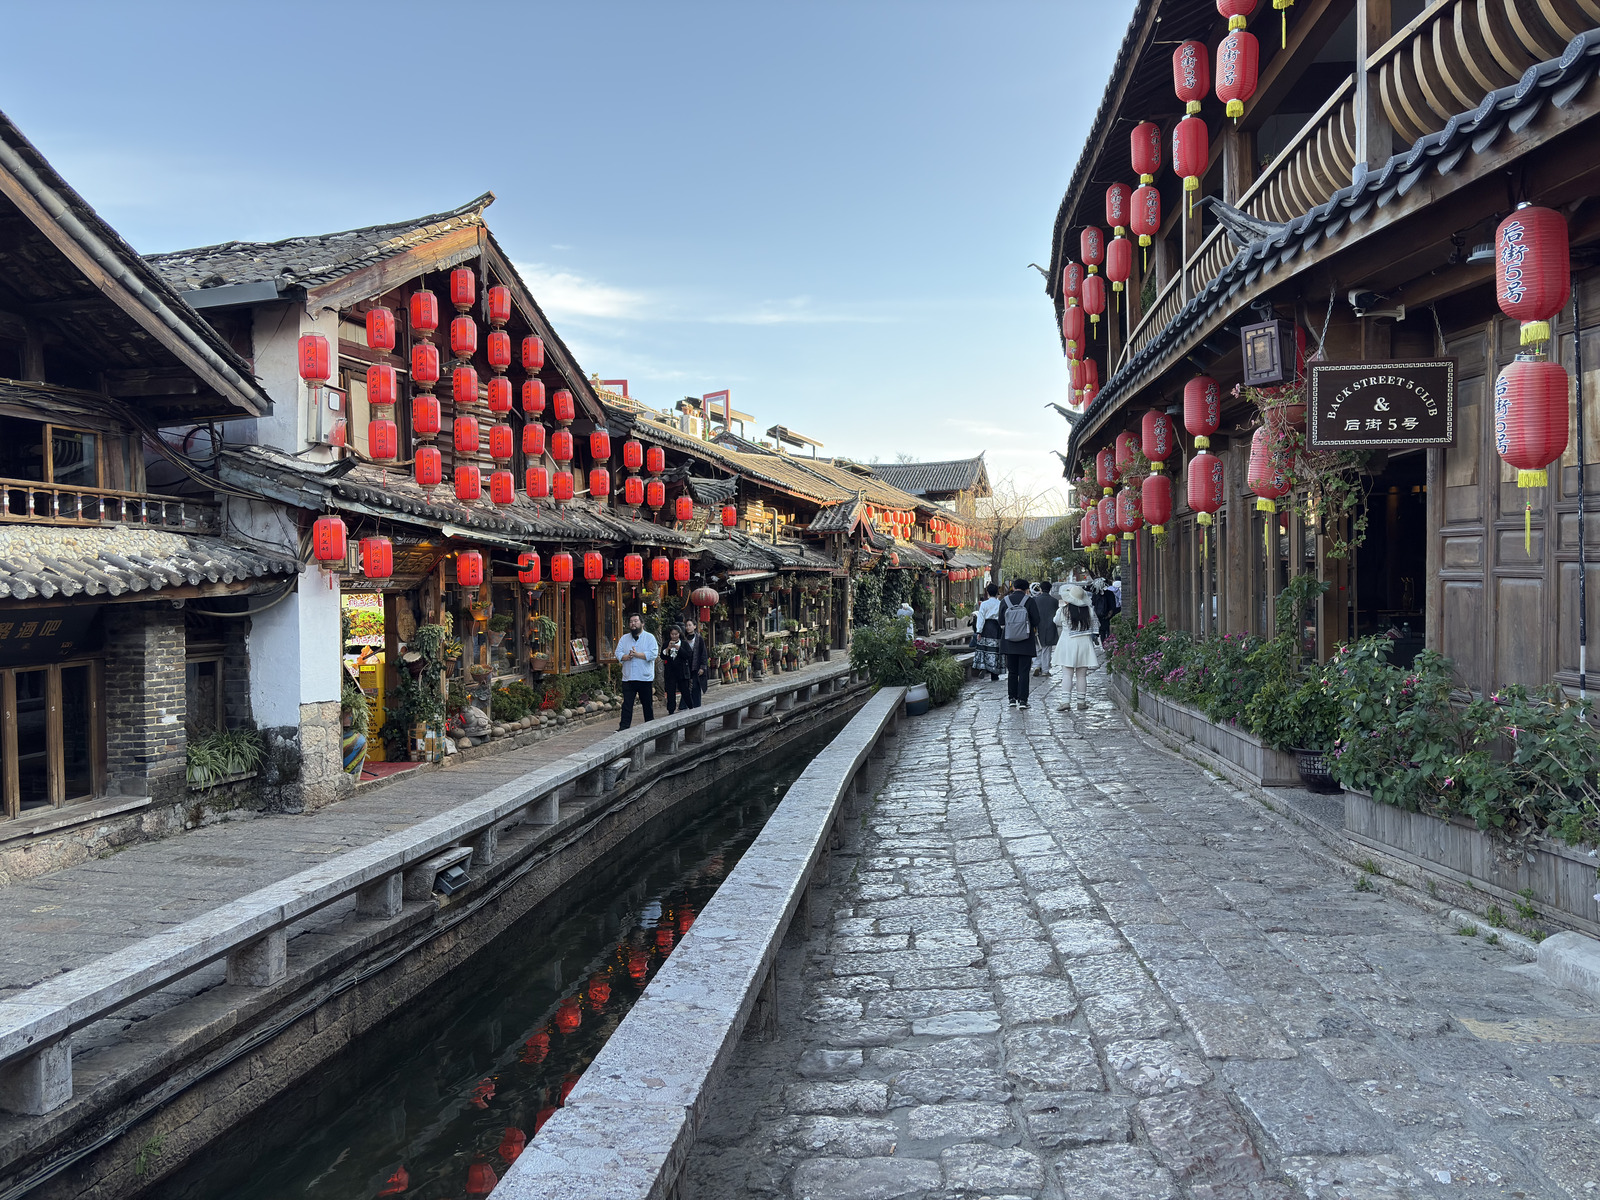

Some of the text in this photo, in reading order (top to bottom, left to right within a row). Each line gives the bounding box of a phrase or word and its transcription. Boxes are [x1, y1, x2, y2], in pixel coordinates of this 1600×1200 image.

[1180, 44, 1198, 89] 后街5号
[1222, 36, 1240, 86] 后街5号
[1110, 186, 1122, 219] 后街5号
[1146, 190, 1158, 226] 后街5号
[1501, 221, 1529, 304] 后街5号
[1205, 382, 1218, 426] 后街5号
[1327, 375, 1438, 419] BACK STREET 5 CLUB
[1373, 397, 1391, 412] &
[1495, 376, 1513, 455] 后街5号
[1154, 416, 1167, 454] 后街5号
[1344, 417, 1419, 431] 后街5号
[1211, 461, 1223, 505] 后街5号
